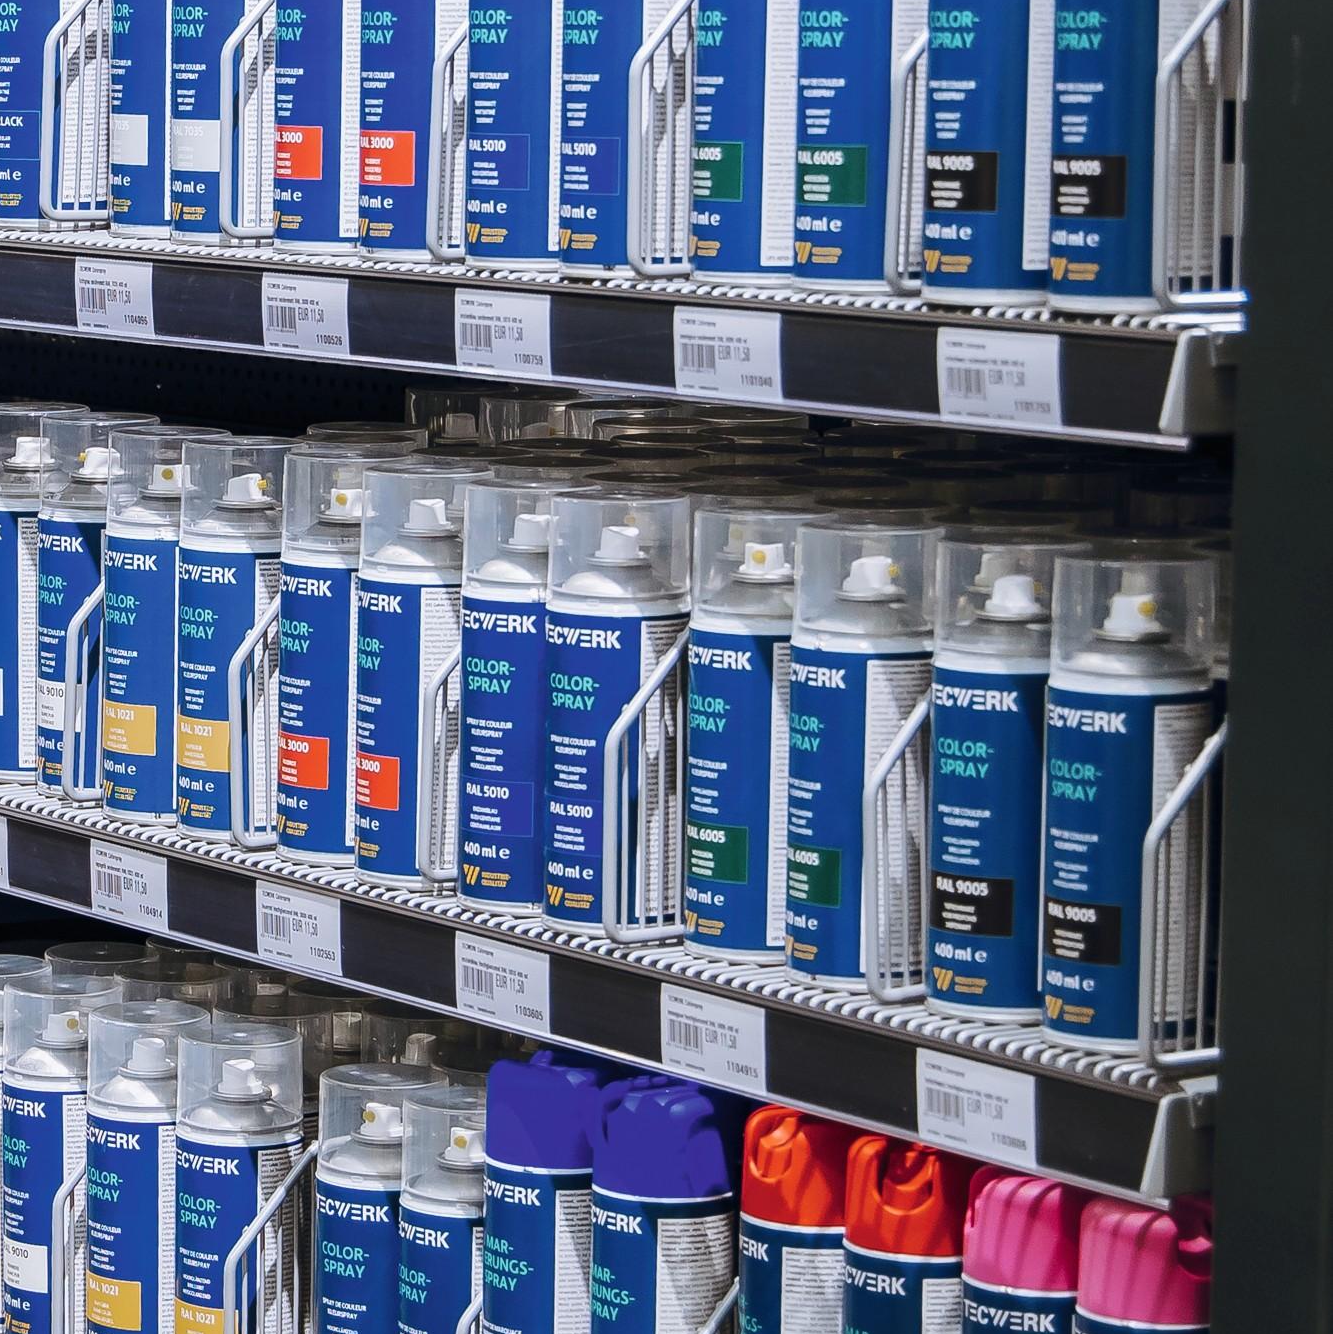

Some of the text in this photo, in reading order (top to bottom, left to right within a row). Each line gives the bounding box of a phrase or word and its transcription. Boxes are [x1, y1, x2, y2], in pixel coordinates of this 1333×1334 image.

[174, 24, 204, 37] SPRAY
[471, 29, 507, 43] SPRAY
[371, 137, 393, 149] 3000
[483, 140, 506, 151] 5010
[107, 289, 131, 305] EUR 11,50
[298, 307, 324, 325] EUR 11,50
[494, 326, 523, 342] EUR 11,50
[181, 606, 218, 622] COLOR-
[182, 623, 214, 639] SPRAY
[467, 658, 515, 675] COLOR-
[469, 676, 511, 693] SPRAY
[551, 673, 599, 692] COLOR-
[553, 692, 594, 710] SPRAY
[194, 725, 211, 736] 1021
[288, 740, 309, 753] 3000
[938, 738, 993, 758] COLOR-
[941, 758, 988, 778] SPRAY
[1051, 759, 1101, 780] COLOR-
[191, 780, 202, 791] ml
[467, 783, 509, 799] RAL 5010
[1052, 780, 1096, 801] SPRAY
[550, 802, 592, 818] RAL 5010
[464, 842, 496, 858] 400 ml
[548, 862, 580, 878] 400 ml
[123, 877, 147, 895] EUR 11,50
[937, 877, 988, 896] RAL 9005
[140, 904, 162, 918] 1104914
[1065, 906, 1096, 922] 9005
[292, 918, 318, 937] EUR 11,50
[310, 947, 335, 961] 1102553
[935, 943, 971, 961] 400 ml
[496, 974, 524, 994] EUR 11,50
[179, 1193, 221, 1212] COLOR-
[316, 1193, 389, 1222] TECWERK
[181, 1210, 216, 1228] SPRAY
[323, 1241, 369, 1261] COLOR-
[487, 1234, 513, 1254] MAR-
[325, 1259, 365, 1278] SPRAY
[342, 1303, 366, 1311] COULEUR
[964, 1298, 1055, 1332] TECWERK
[181, 1308, 214, 1324] RAL 1021
